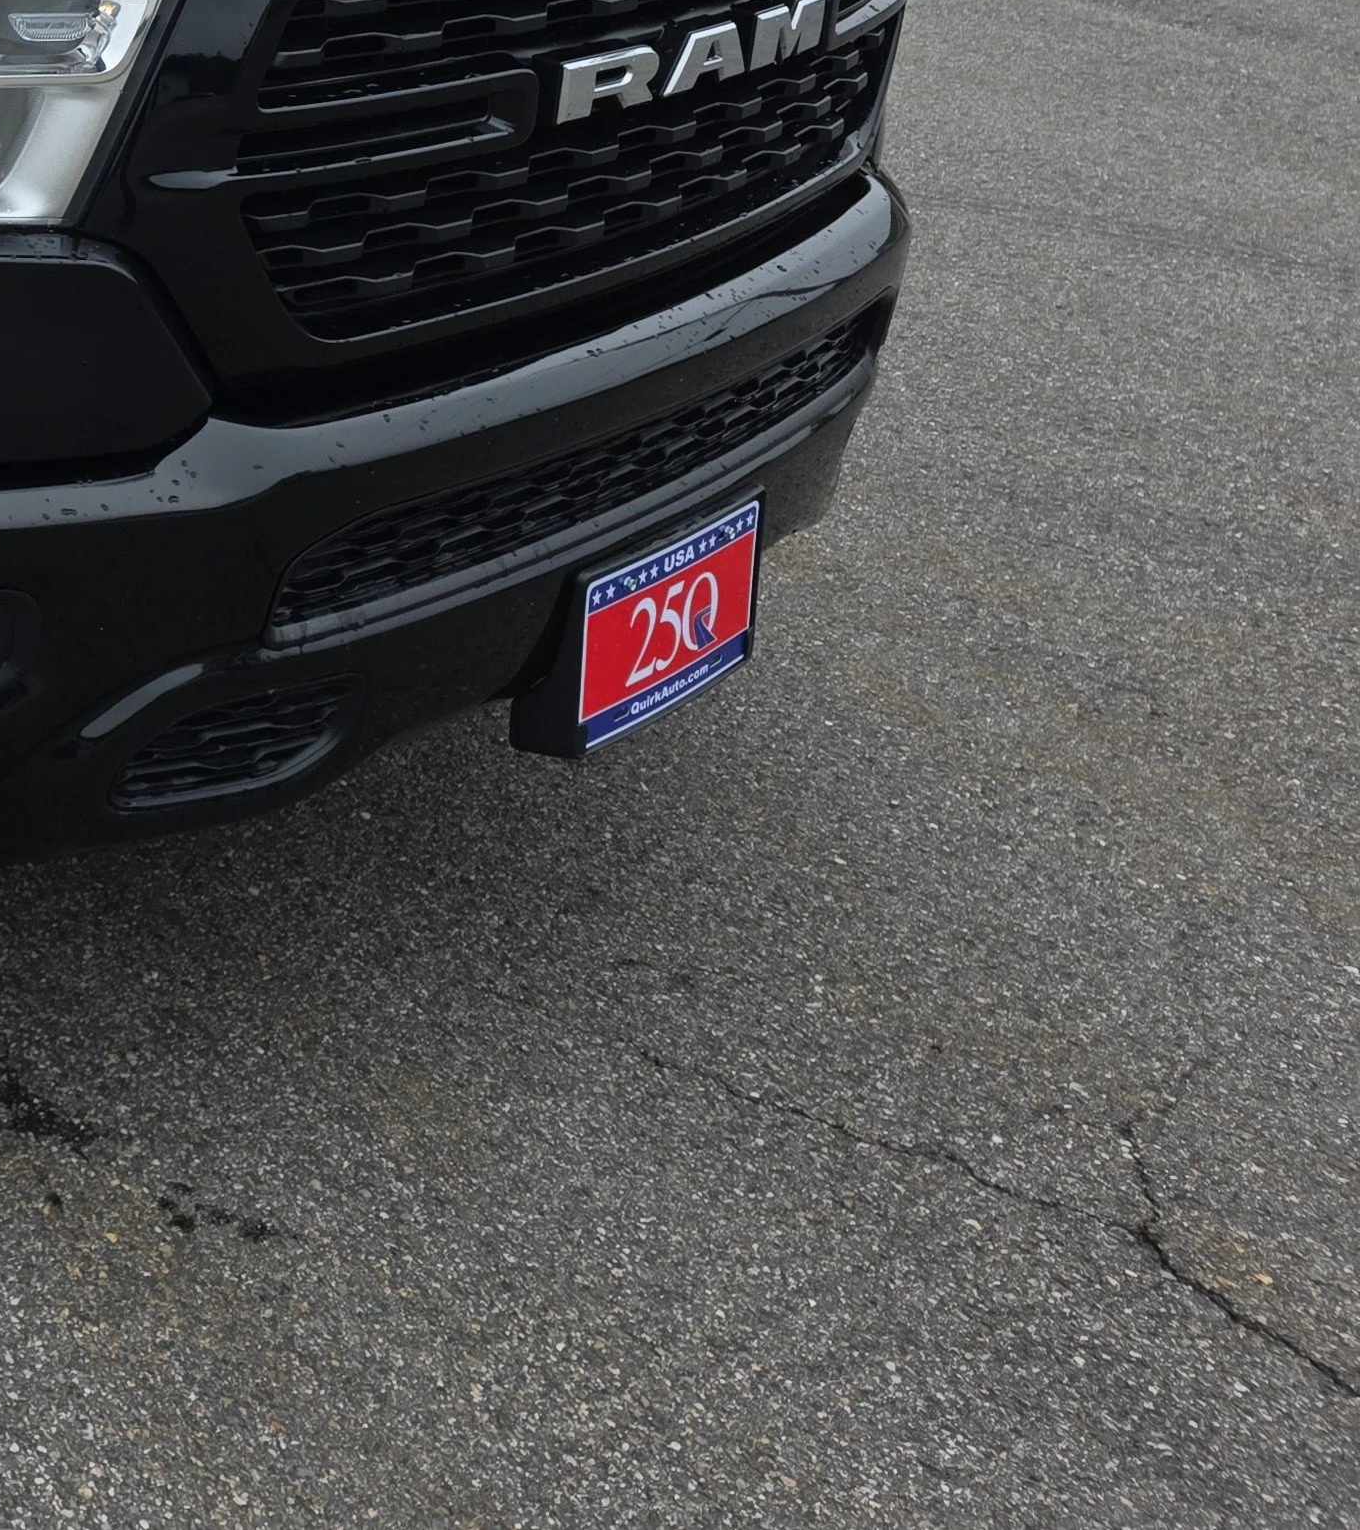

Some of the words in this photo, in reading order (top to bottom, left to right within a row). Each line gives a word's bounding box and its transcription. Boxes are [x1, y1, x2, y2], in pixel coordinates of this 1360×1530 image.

[663, 545, 695, 573] USA
[625, 571, 719, 688] 250
[630, 663, 709, 716] QuirkAuto.com
